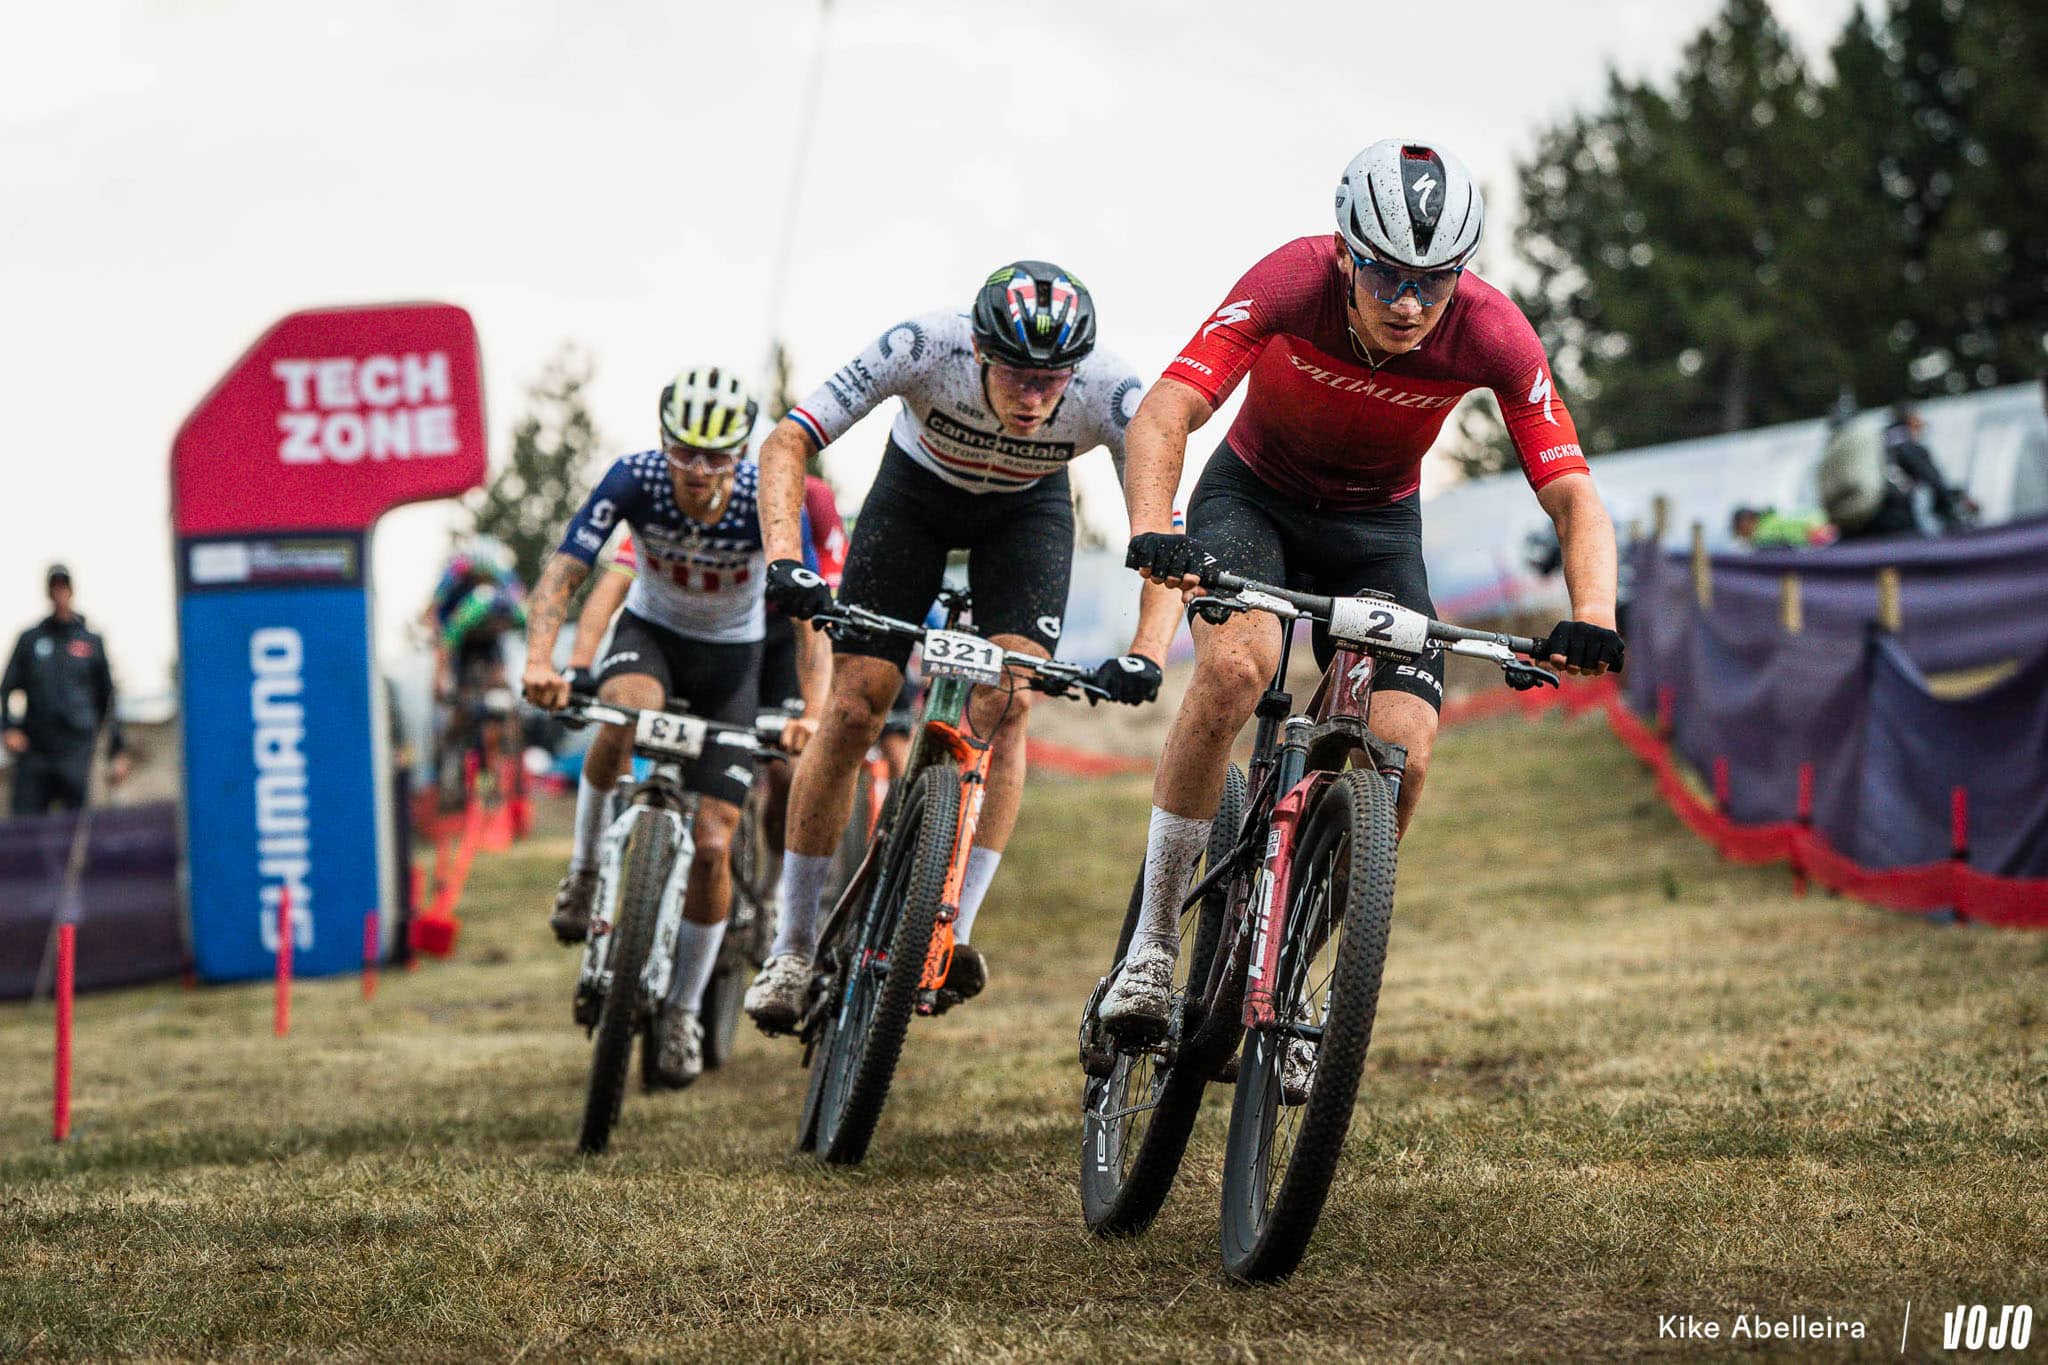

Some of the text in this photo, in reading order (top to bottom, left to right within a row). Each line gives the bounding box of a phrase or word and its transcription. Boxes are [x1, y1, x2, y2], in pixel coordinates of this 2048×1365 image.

[273, 352, 449, 408] TECH
[1176, 356, 1213, 376] RAM
[277, 406, 458, 464] ZONE
[1365, 610, 1395, 642] 2
[929, 637, 993, 666] 321
[1395, 664, 1443, 698] SRA
[249, 627, 314, 954] SHIMANO
